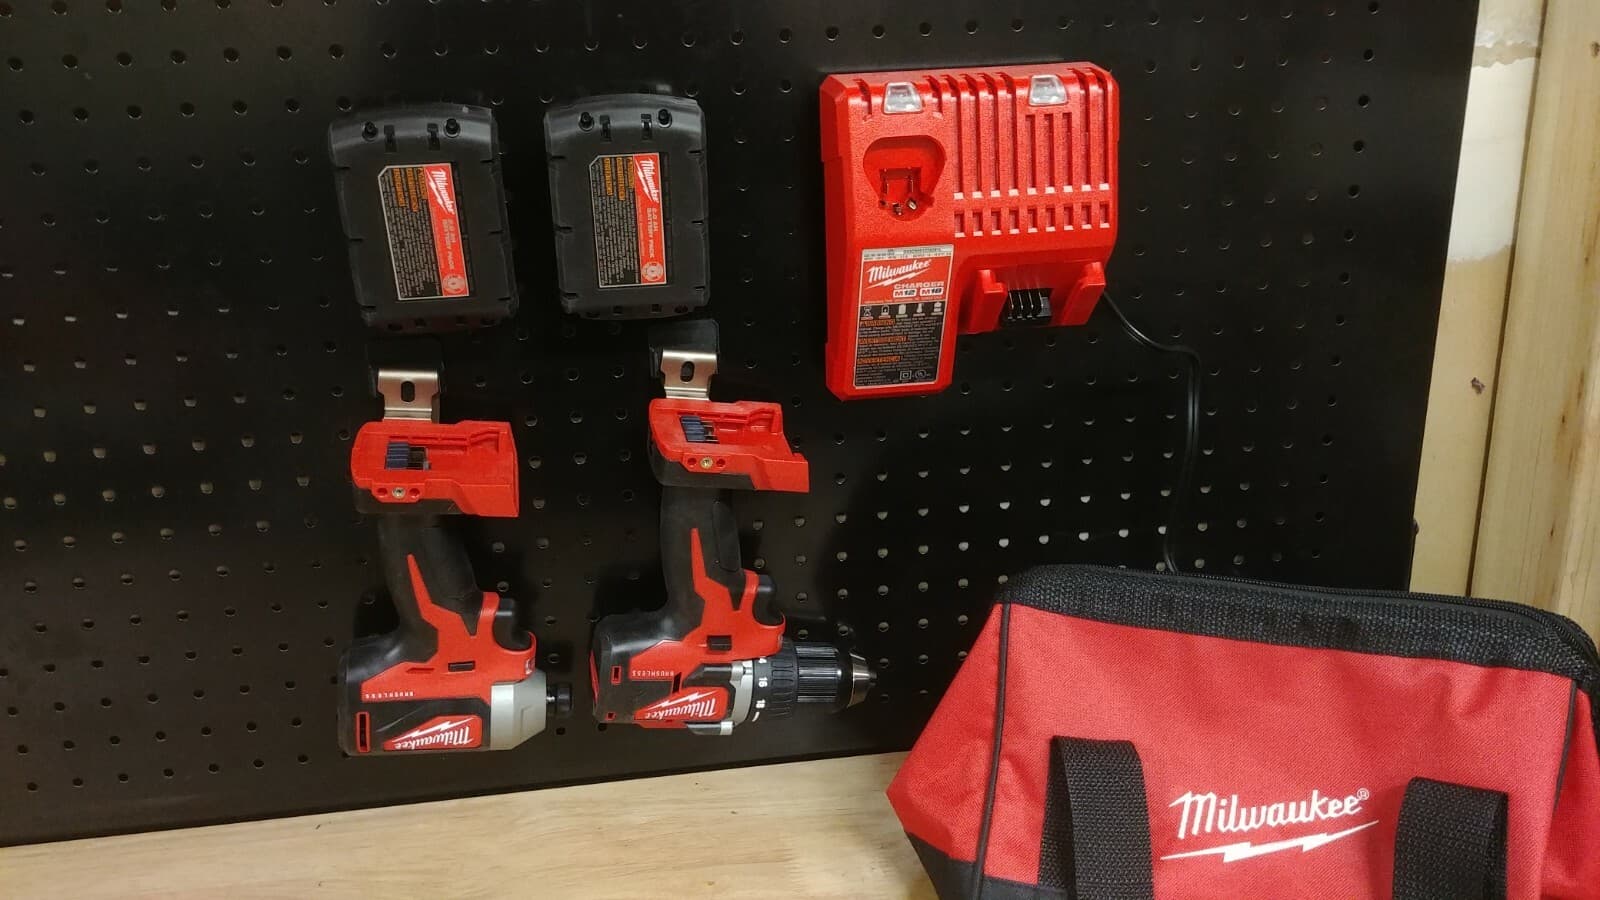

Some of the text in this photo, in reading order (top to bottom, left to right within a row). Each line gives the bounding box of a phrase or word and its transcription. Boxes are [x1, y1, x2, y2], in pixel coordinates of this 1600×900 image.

[430, 169, 455, 215] Milwaukee
[639, 158, 661, 204] Milwaukee
[442, 218, 456, 270] BATTERY PACK
[646, 207, 656, 258] BATTERY PACK
[866, 259, 931, 283] Milwaukee
[894, 281, 944, 289] CHARGER
[894, 287, 942, 297] M12 M18
[632, 669, 674, 678] BRUSHLESS
[758, 677, 768, 688] 16
[364, 691, 414, 699] BRUSHLESS
[756, 699, 766, 709] 18
[644, 697, 717, 721] Milwaukee
[393, 726, 474, 750] Milwaukee
